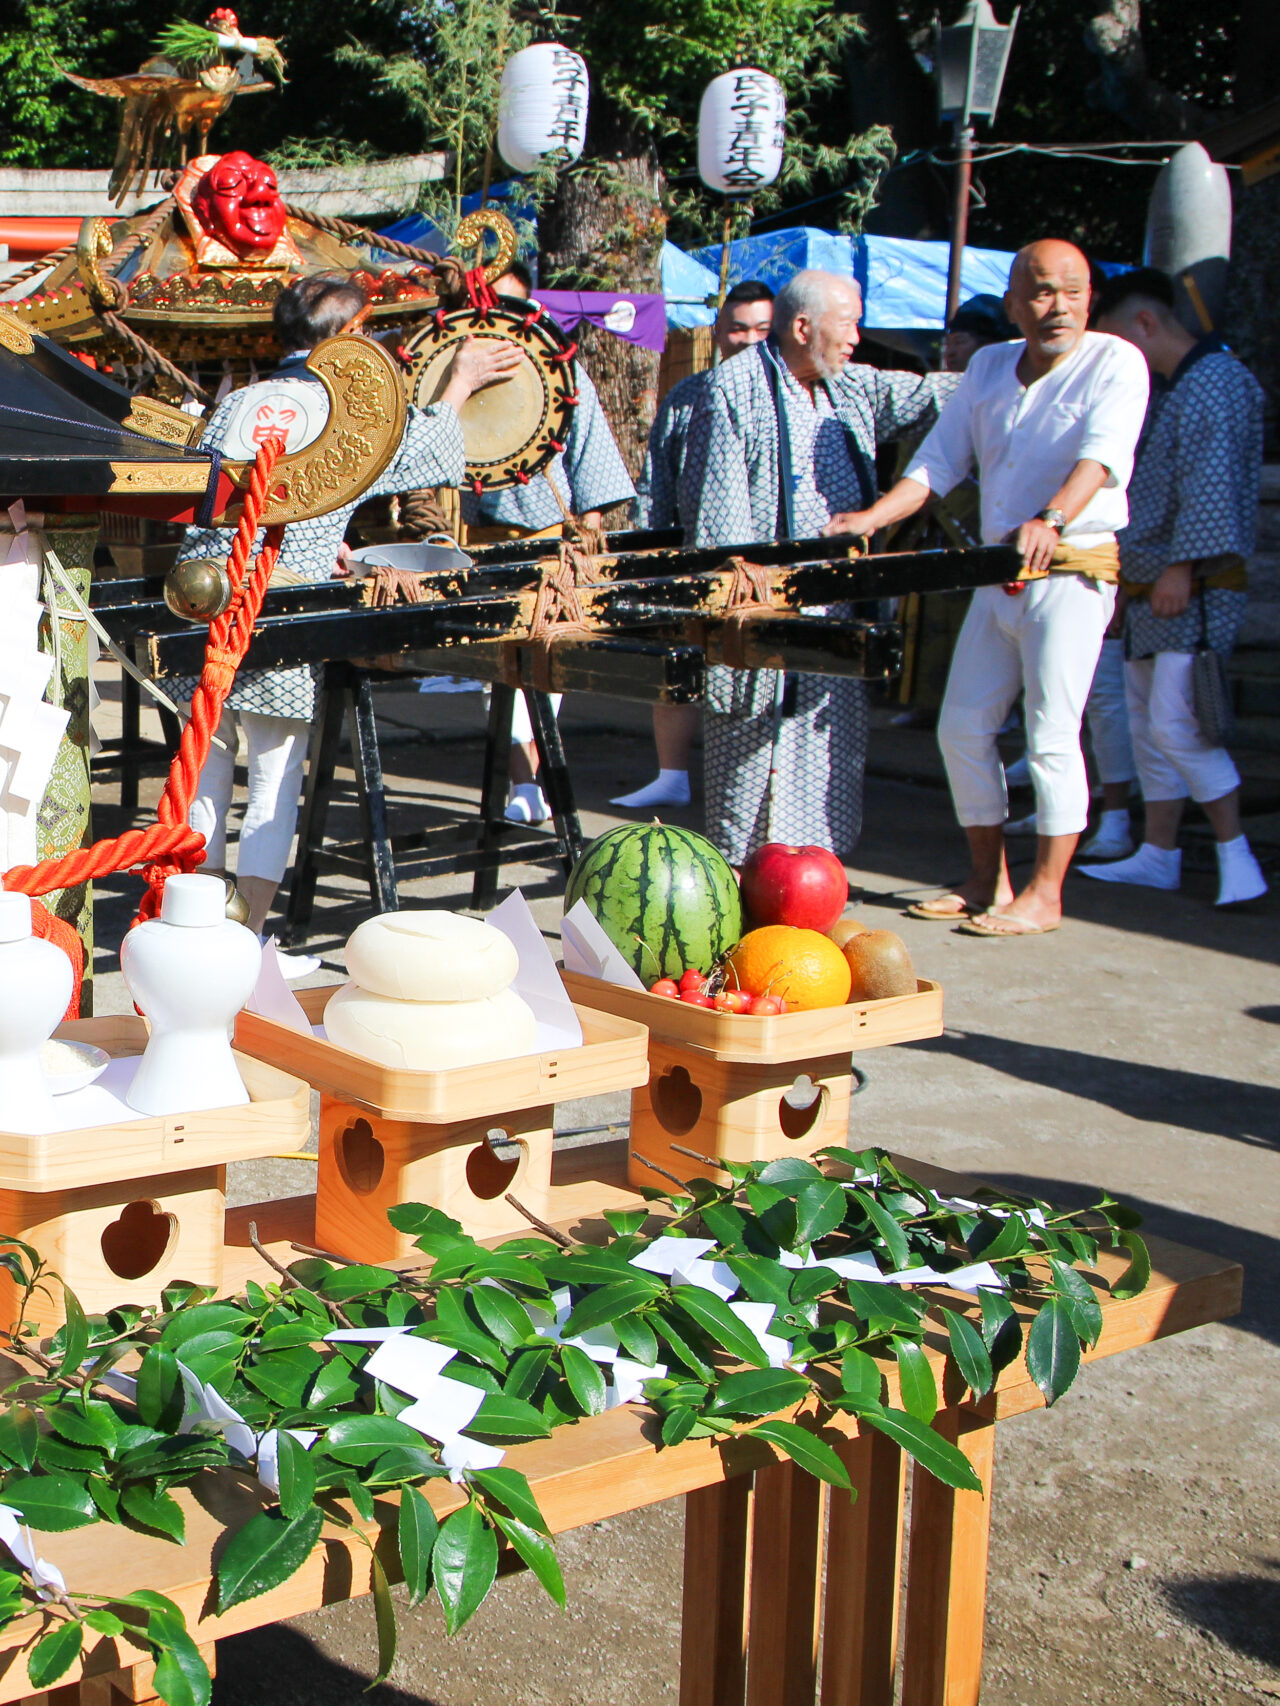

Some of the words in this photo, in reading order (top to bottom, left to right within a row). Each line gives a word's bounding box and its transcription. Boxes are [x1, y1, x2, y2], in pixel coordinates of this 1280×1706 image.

[723, 74, 770, 187] 氏子青年会
